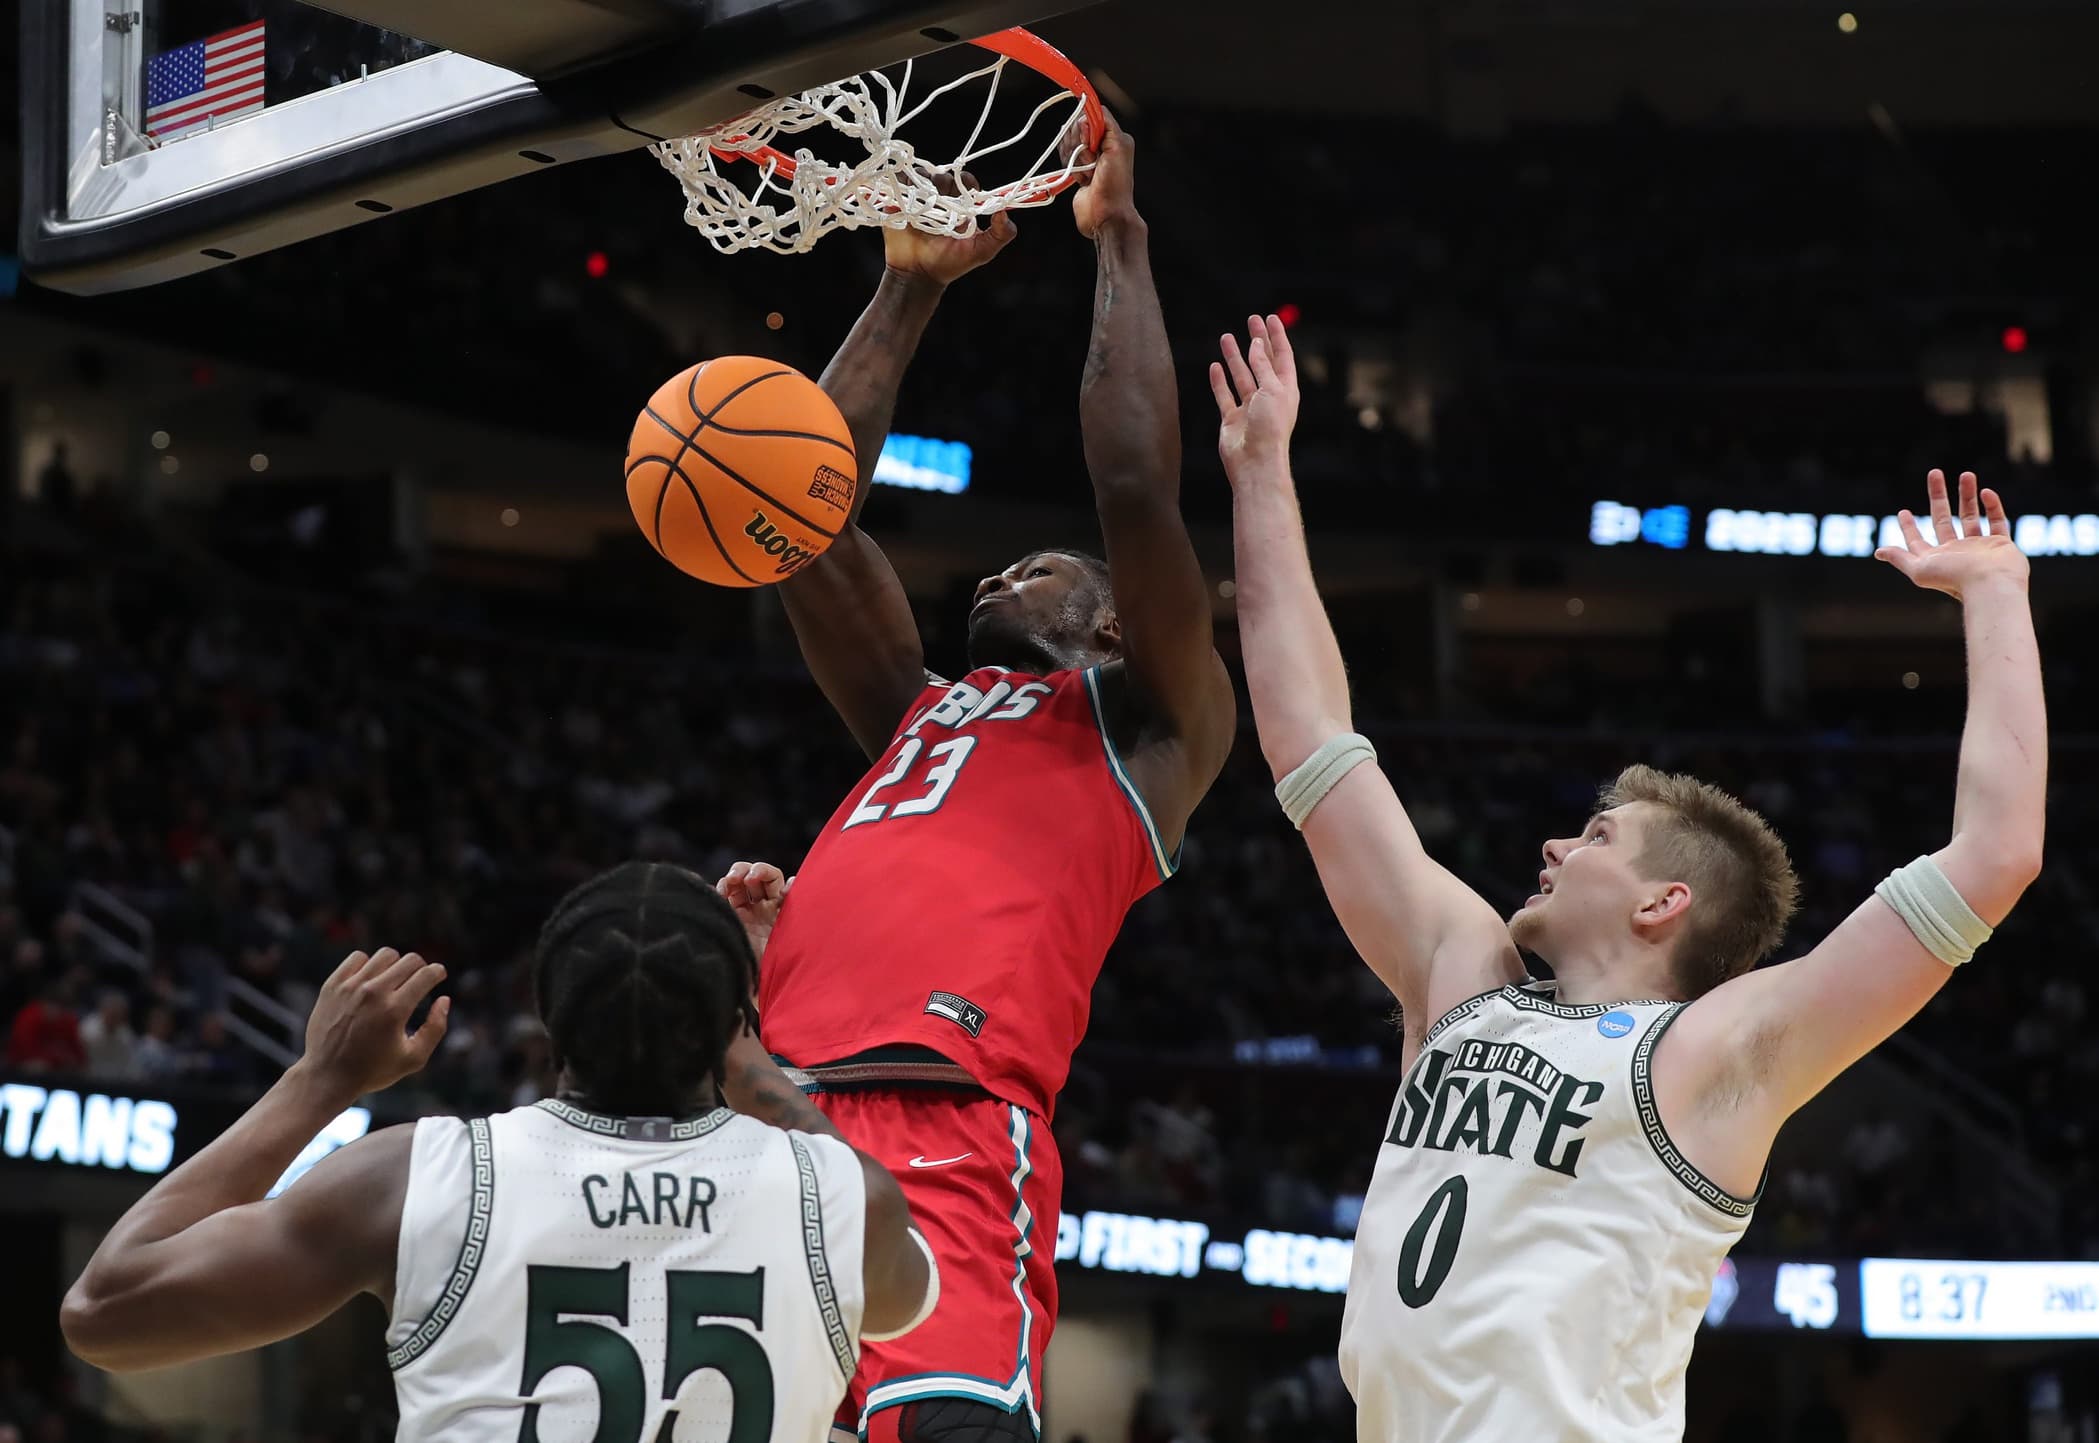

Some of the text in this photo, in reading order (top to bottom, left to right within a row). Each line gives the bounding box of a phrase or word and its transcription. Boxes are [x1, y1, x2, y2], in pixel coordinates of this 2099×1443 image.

[841, 735, 978, 831] 23
[964, 1010, 979, 1029] XL
[1450, 1041, 1558, 1092] ICHIGAN
[0, 1083, 178, 1174] TANS
[1385, 1049, 1605, 1178] STATE
[582, 1172, 717, 1233] CARR
[1398, 1174, 1468, 1309] 0
[1081, 1211, 1208, 1277] FIRST
[1775, 1262, 1838, 1328] 45
[518, 1261, 775, 1443] 55
